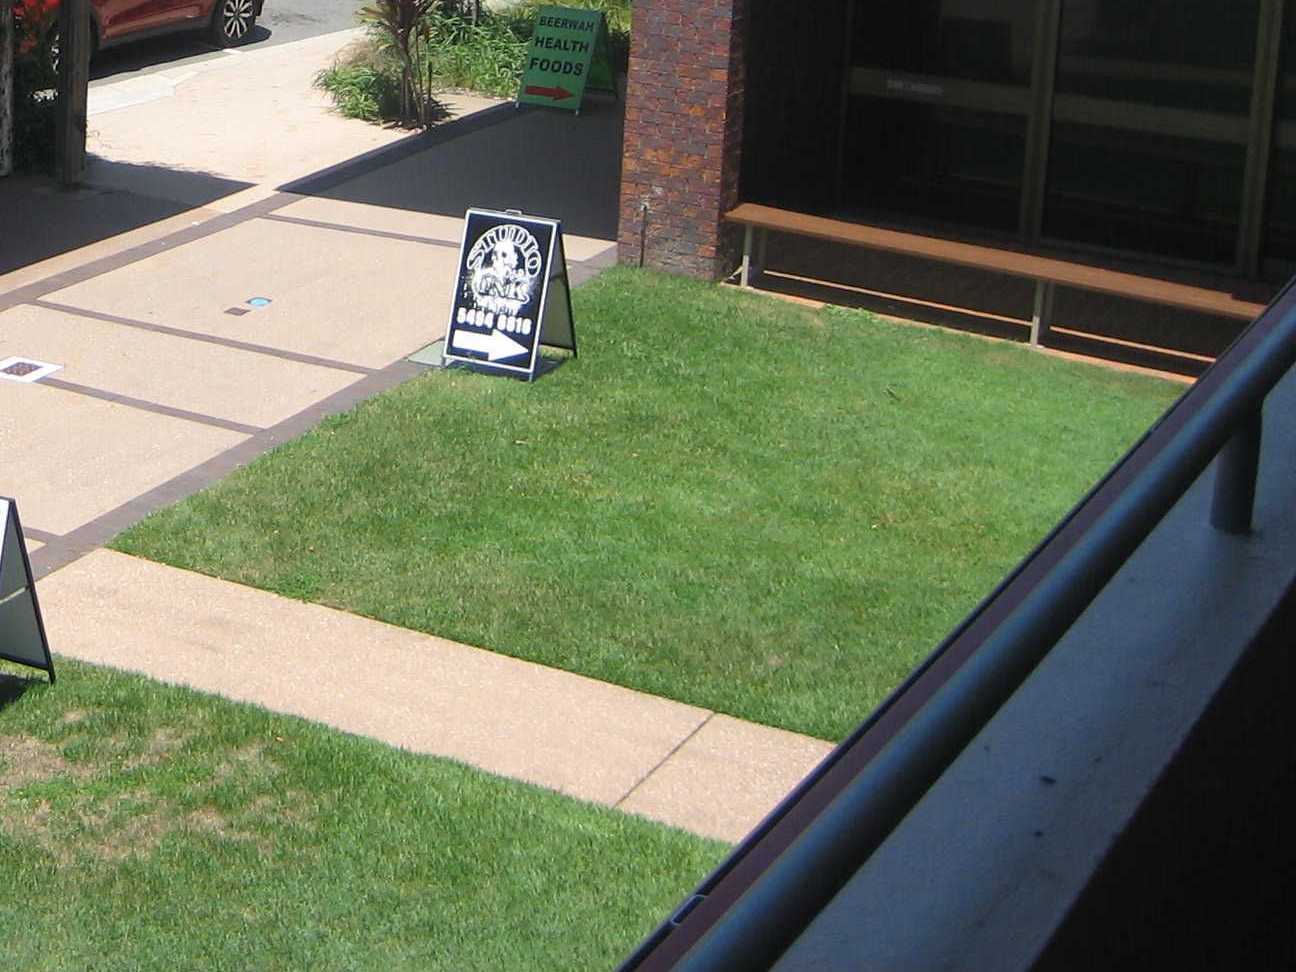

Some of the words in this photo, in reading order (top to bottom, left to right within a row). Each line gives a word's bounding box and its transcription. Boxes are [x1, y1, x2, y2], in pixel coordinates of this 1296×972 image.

[539, 16, 595, 32] BEERWAH
[534, 35, 590, 53] HEALTH
[529, 57, 585, 76] FOODS
